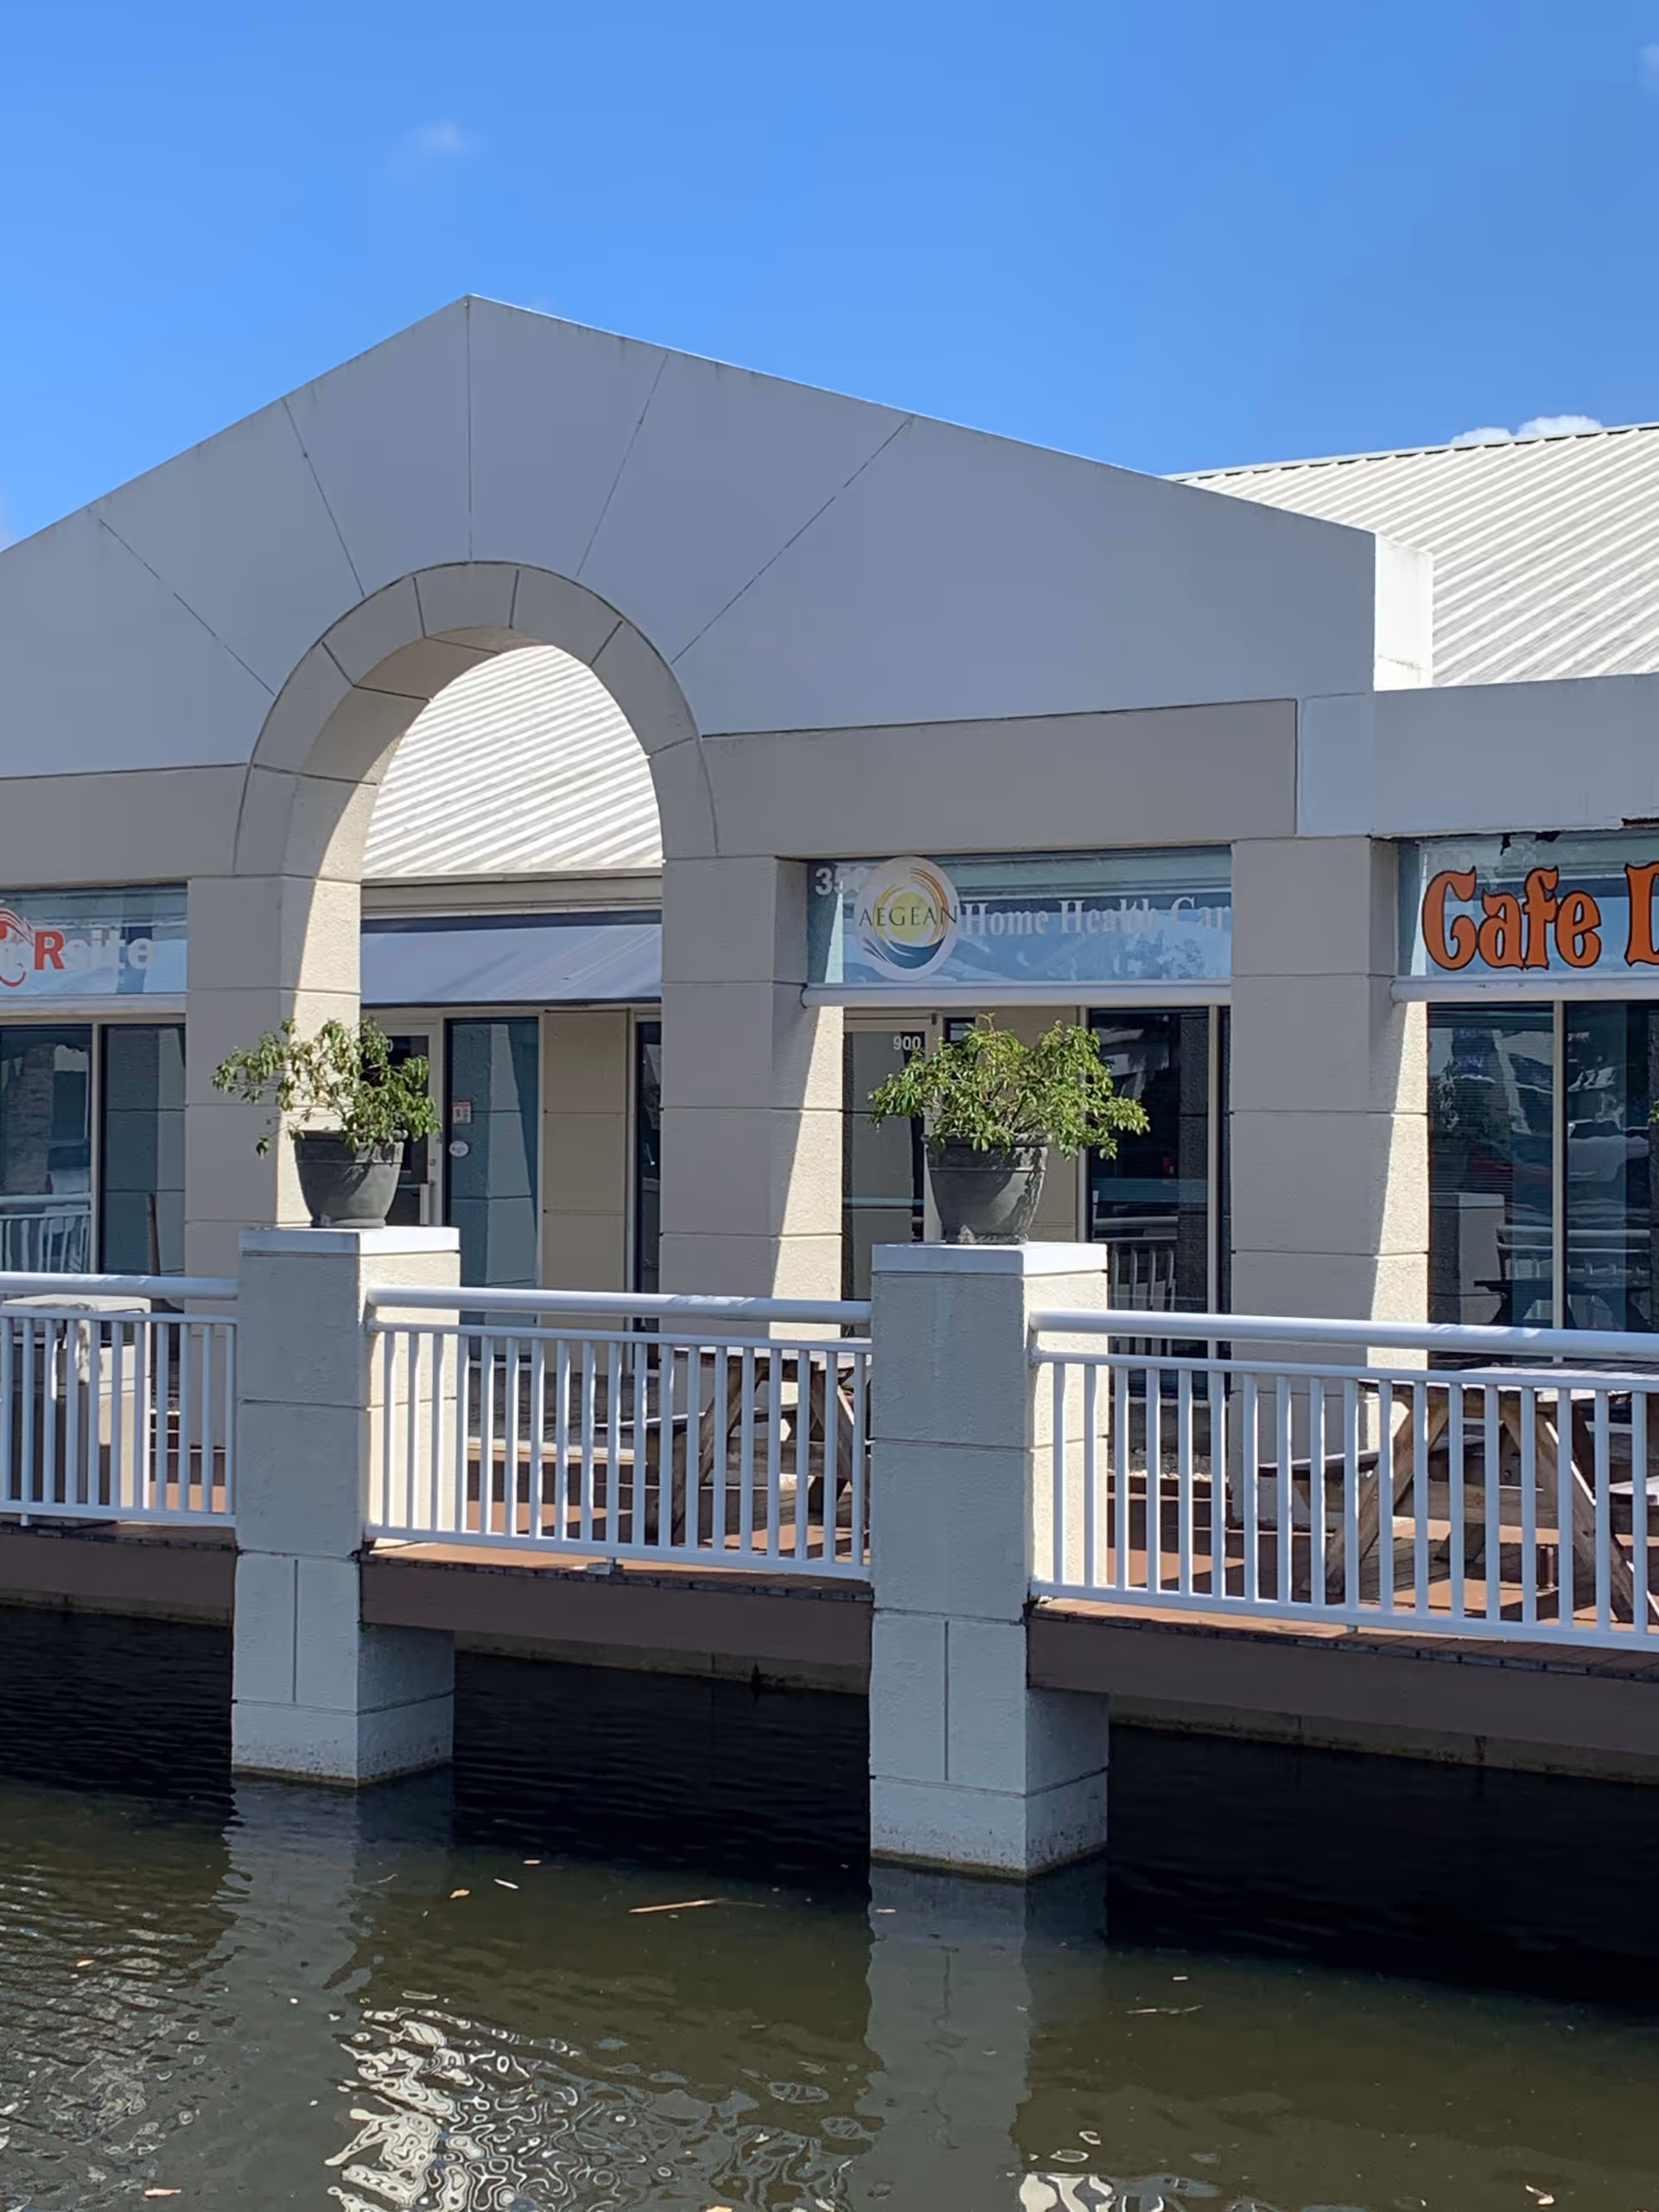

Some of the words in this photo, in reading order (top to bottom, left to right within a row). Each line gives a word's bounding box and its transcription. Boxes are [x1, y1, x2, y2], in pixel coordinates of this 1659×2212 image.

[859, 905, 957, 927] AEGEAN
[962, 902, 1049, 936] Home
[1058, 899, 1160, 934] Health
[1421, 865, 1602, 970] Cafe
[893, 1035, 922, 1052] 900
